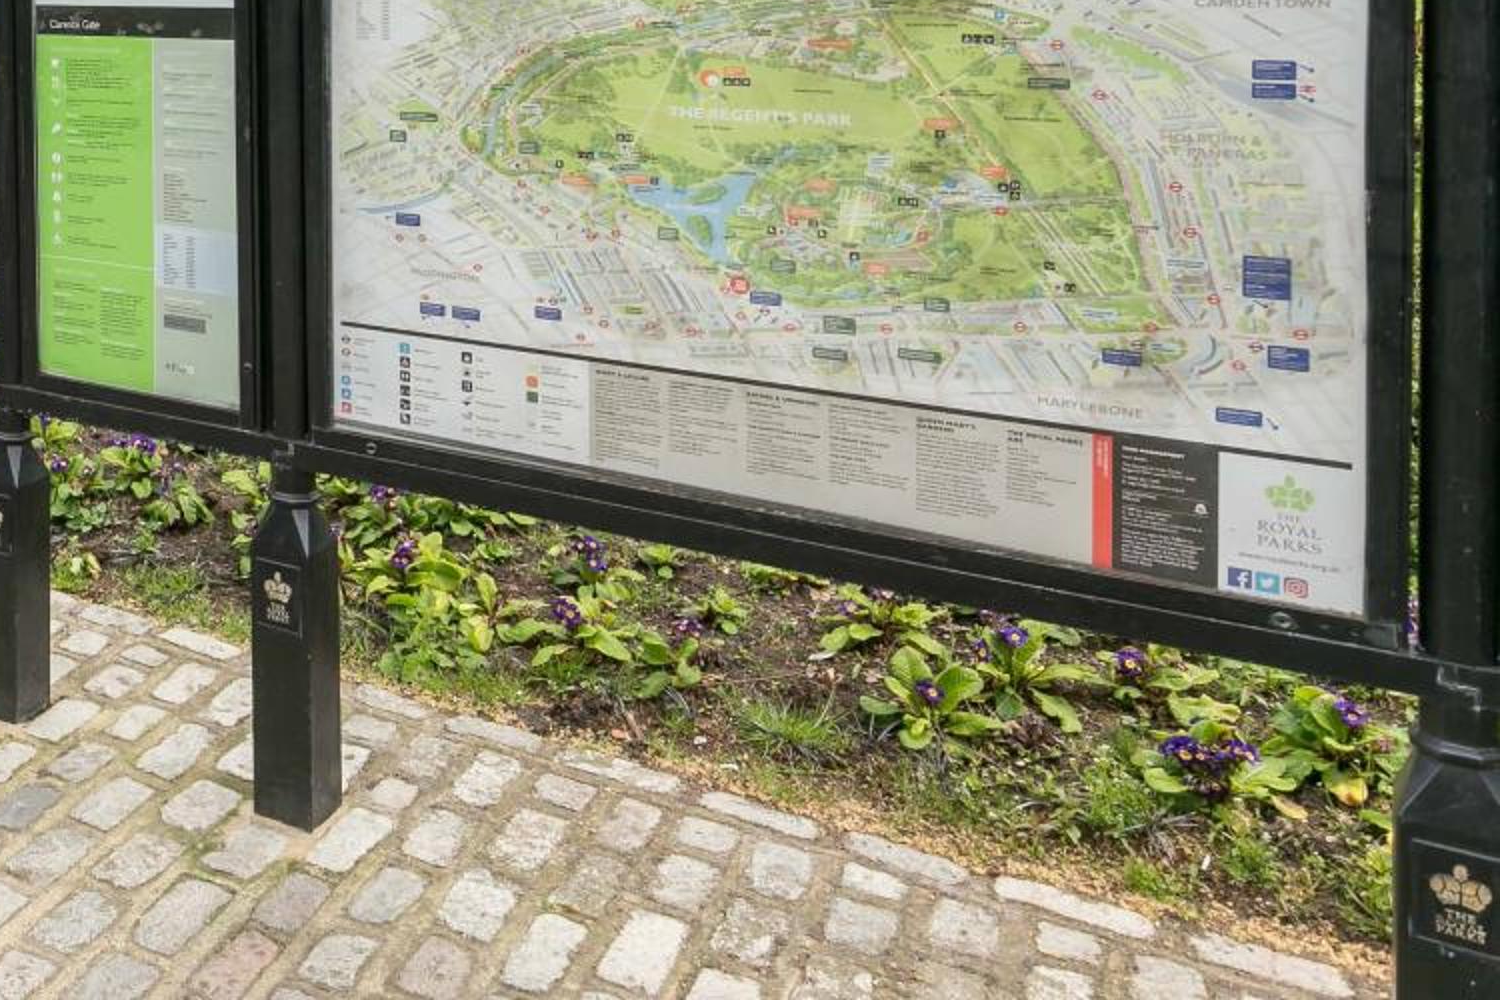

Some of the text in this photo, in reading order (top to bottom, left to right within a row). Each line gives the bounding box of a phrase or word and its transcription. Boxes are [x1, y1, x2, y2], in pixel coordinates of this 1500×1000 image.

[669, 105, 704, 120] THE
[802, 110, 852, 128] PARK
[1257, 519, 1322, 541] ROYAL
[1256, 534, 1323, 555] PARKS
